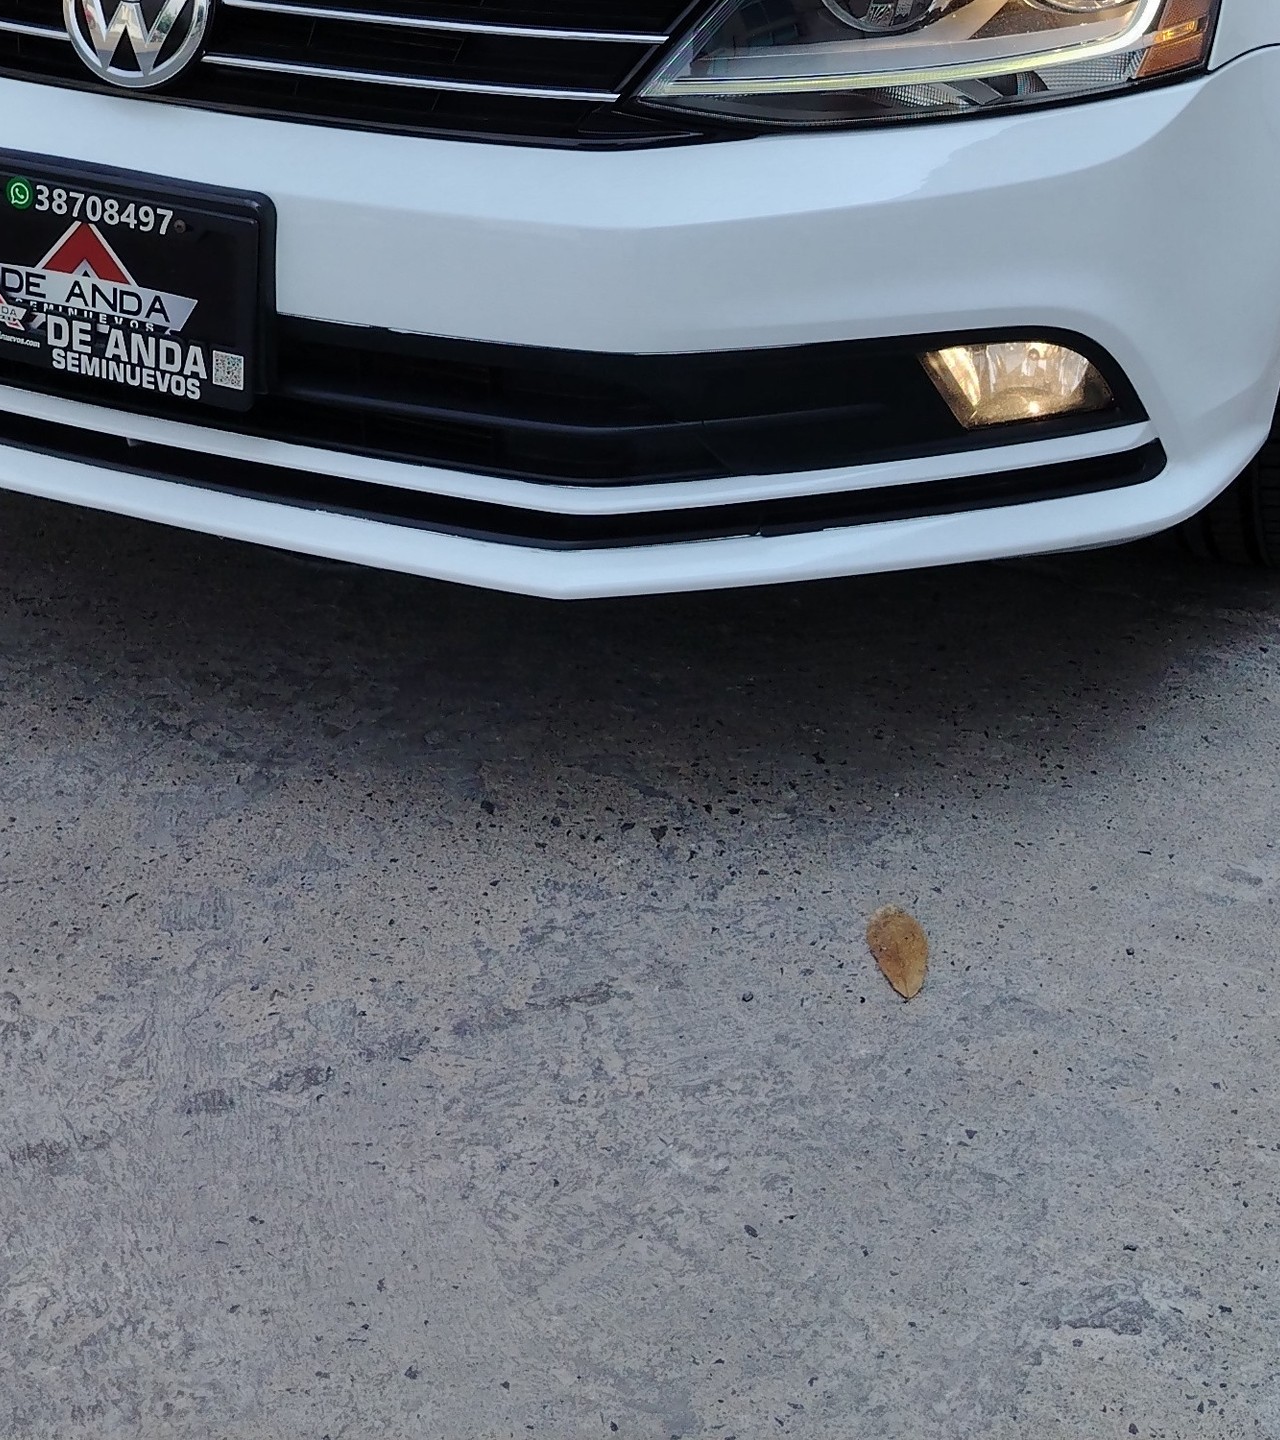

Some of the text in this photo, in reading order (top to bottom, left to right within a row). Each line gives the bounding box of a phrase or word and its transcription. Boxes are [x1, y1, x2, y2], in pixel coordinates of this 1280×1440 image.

[35, 184, 174, 236] 38708497
[1, 266, 171, 323] DE ANDA
[47, 314, 208, 380] DE ANDA
[52, 348, 201, 400] SEMINUEVOS
